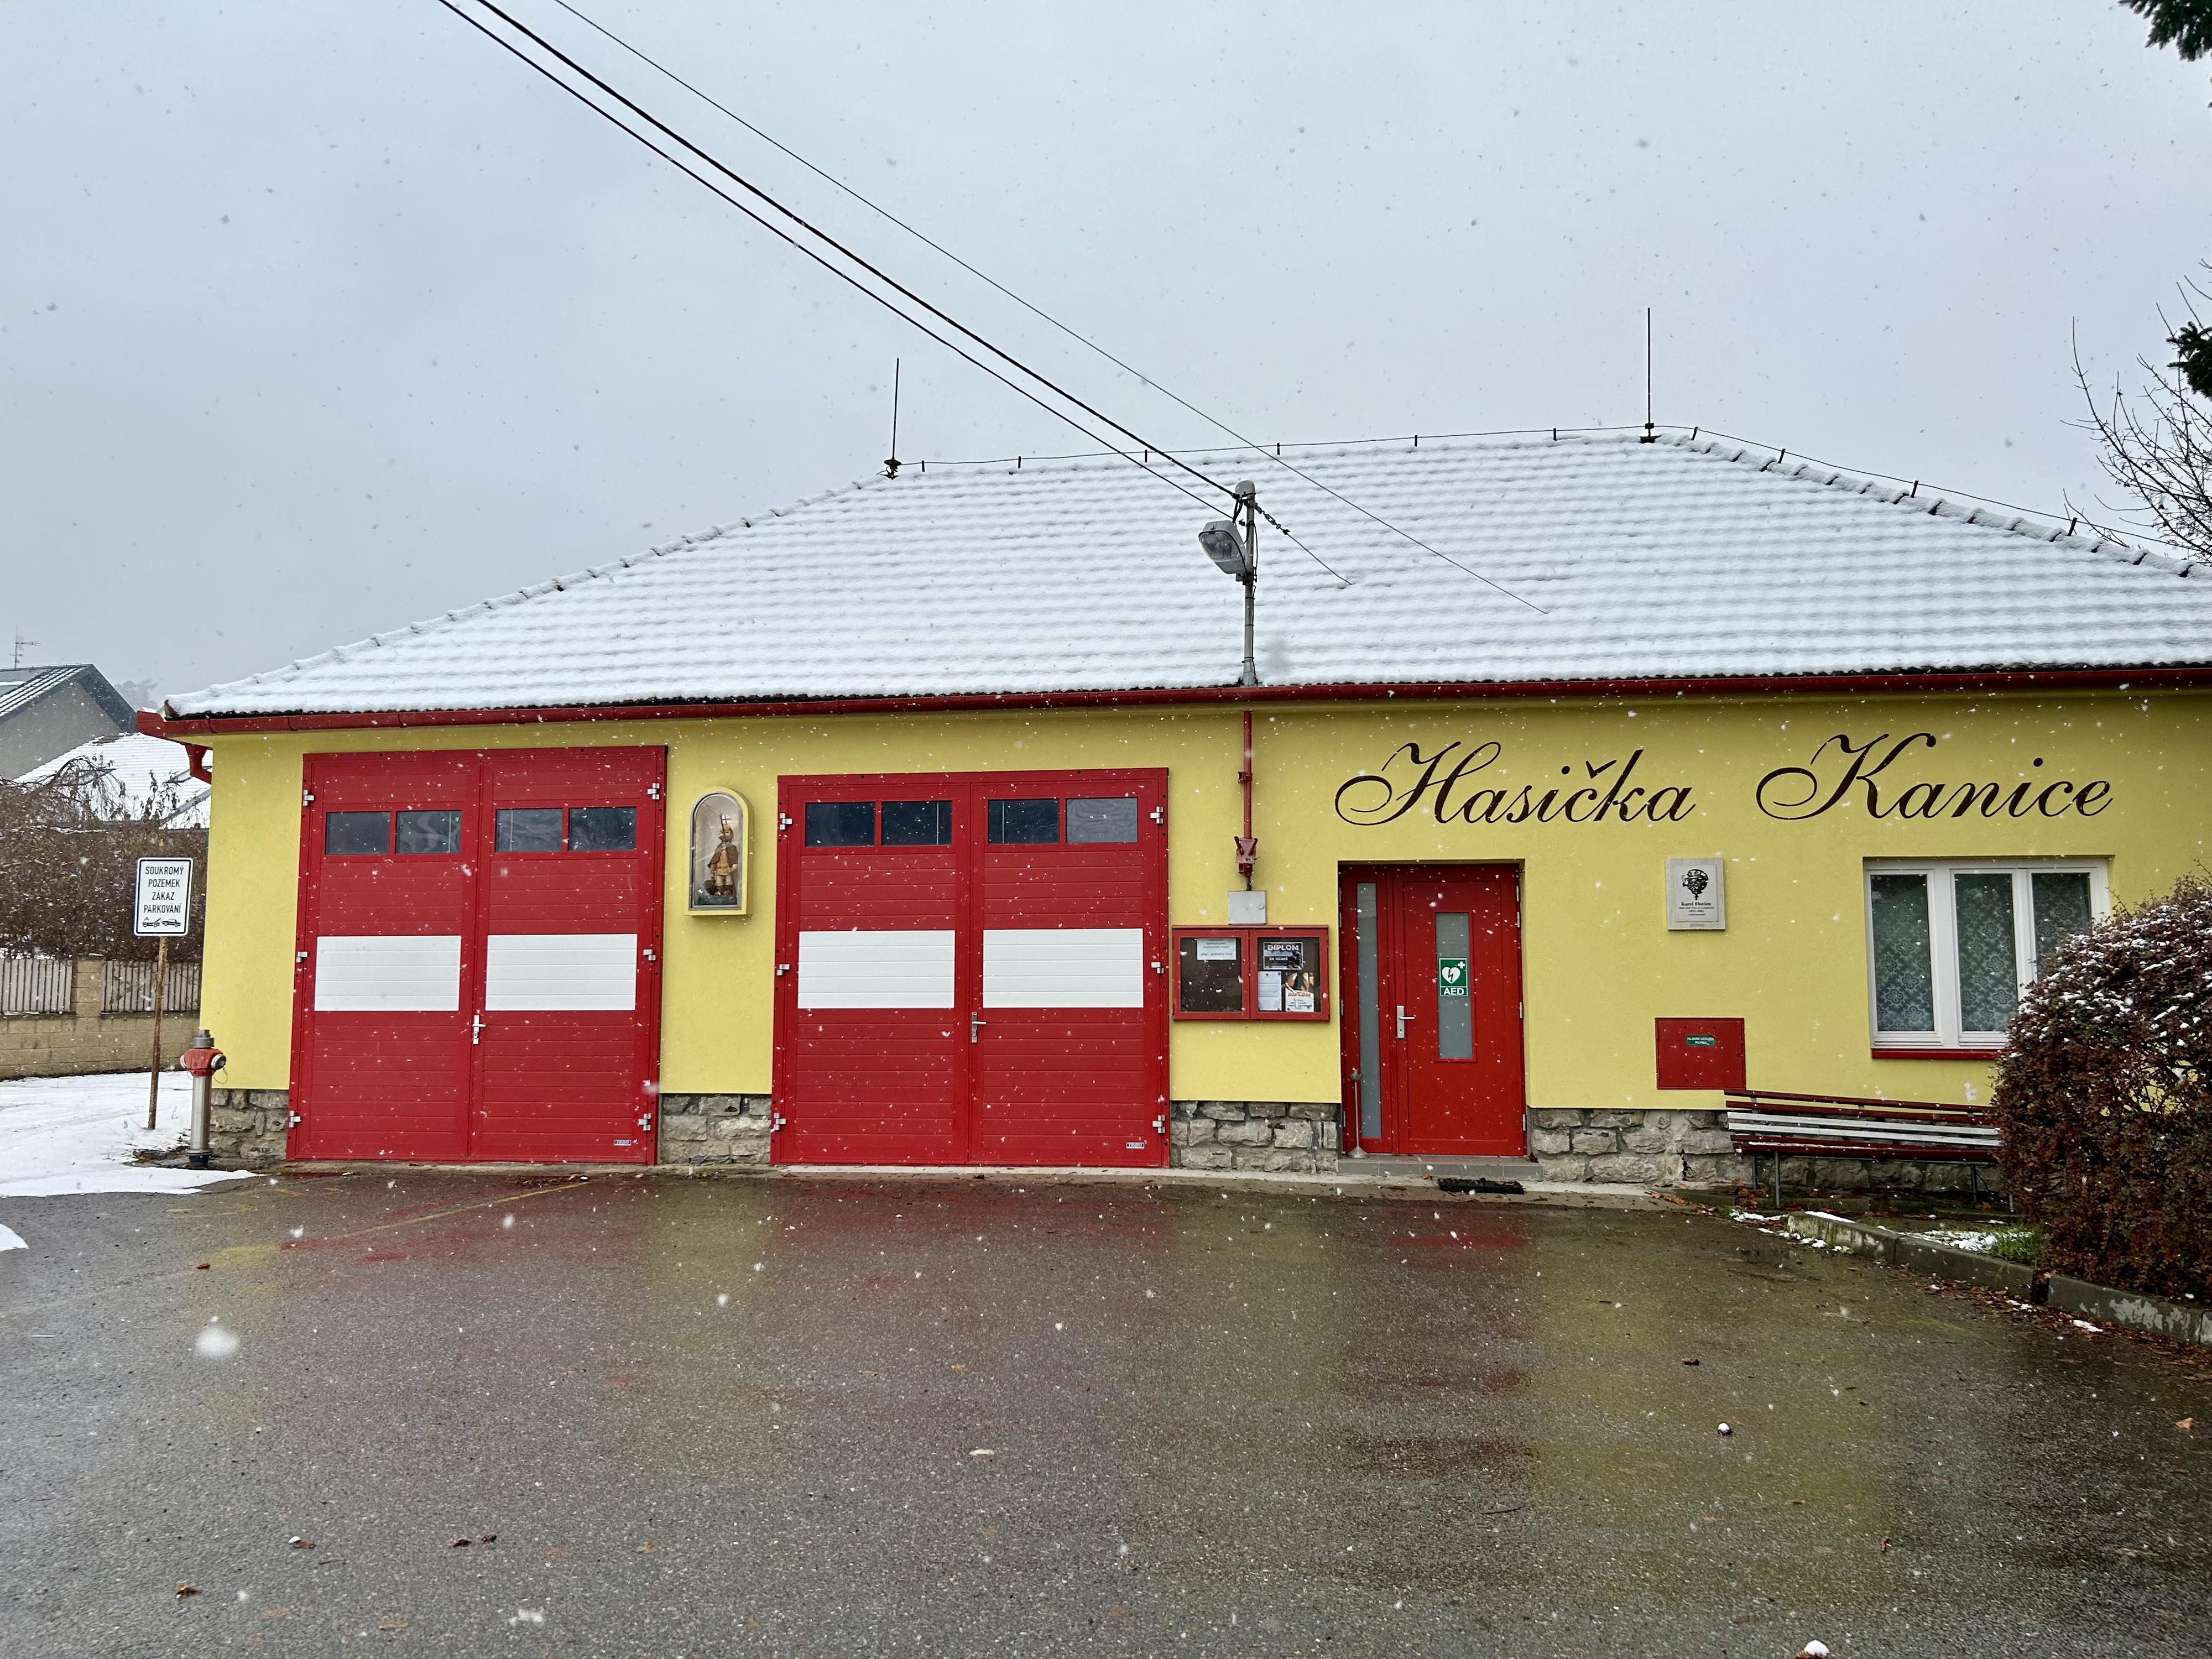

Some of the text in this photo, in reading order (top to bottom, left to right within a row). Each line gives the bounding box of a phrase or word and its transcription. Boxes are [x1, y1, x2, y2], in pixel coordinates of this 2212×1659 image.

[1334, 733, 2114, 826] Hasička Kanice
[145, 864, 185, 875] SOUKROMÝ
[148, 879, 180, 888] POZEMEK
[152, 889, 175, 900] ZÁKAZ
[144, 902, 181, 914] PARKOVÁNÍ
